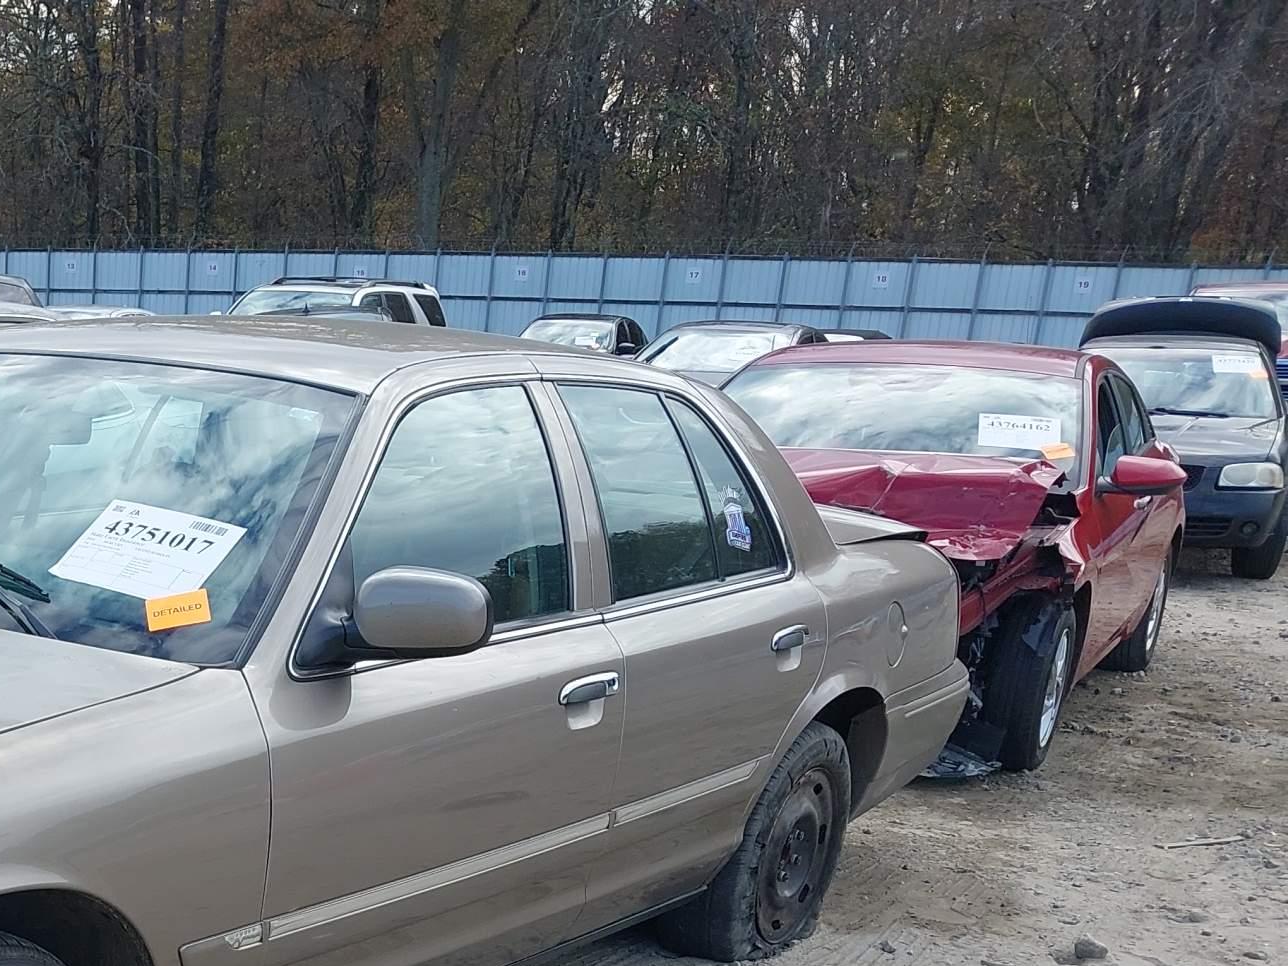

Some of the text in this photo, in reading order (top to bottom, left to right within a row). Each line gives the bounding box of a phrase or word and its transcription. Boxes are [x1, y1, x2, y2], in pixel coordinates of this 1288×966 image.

[689, 271, 700, 279] 17
[1078, 281, 1090, 289] 19
[104, 519, 217, 555] 43751017
[152, 602, 203, 619] DETAILED
